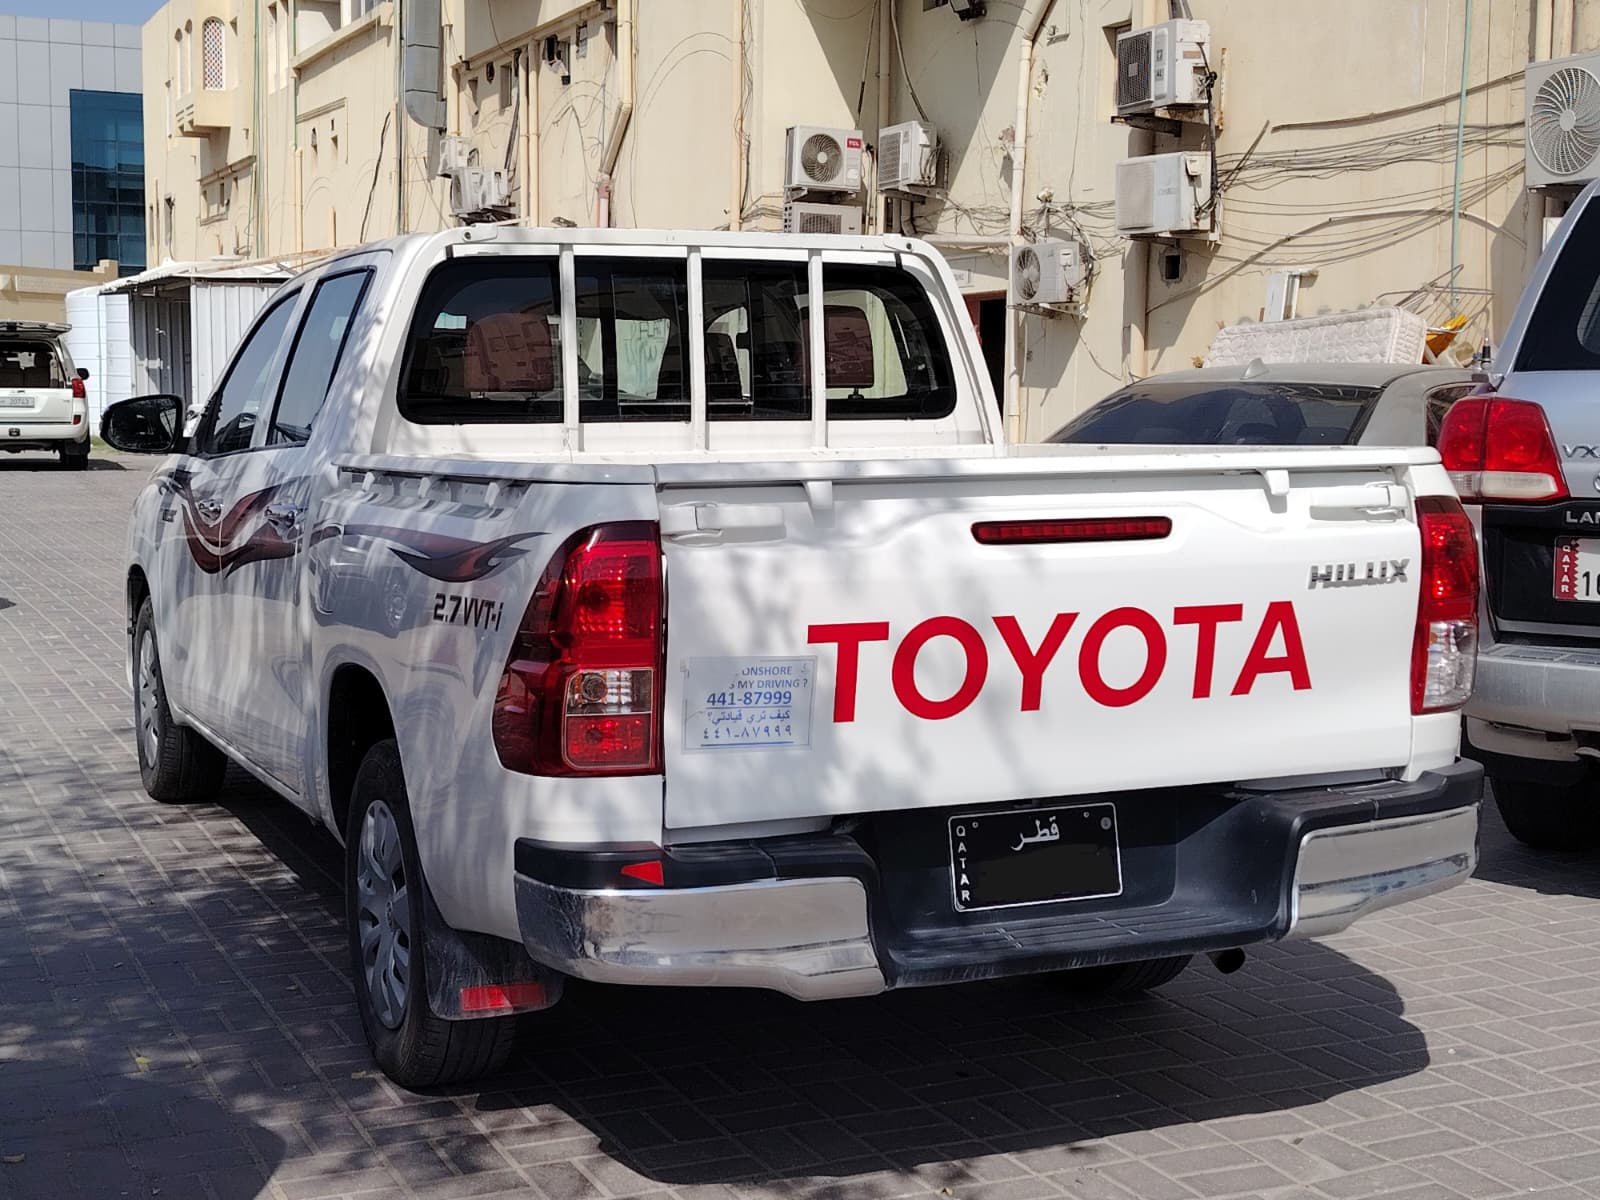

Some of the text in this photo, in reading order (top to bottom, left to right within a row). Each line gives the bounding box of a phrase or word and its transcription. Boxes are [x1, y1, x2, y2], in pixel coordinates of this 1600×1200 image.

[1309, 559, 1410, 586] HILUX
[1561, 545, 1571, 593] QATAR
[742, 666, 792, 676] ONSHORE
[807, 600, 1312, 723] TOYOTA
[737, 680, 755, 689] MY
[757, 679, 800, 689] DRIVING
[707, 691, 792, 706] 441-87999
[769, 709, 790, 722] كيف
[1011, 816, 1060, 851] قطر
[956, 825, 970, 901] QATAR
